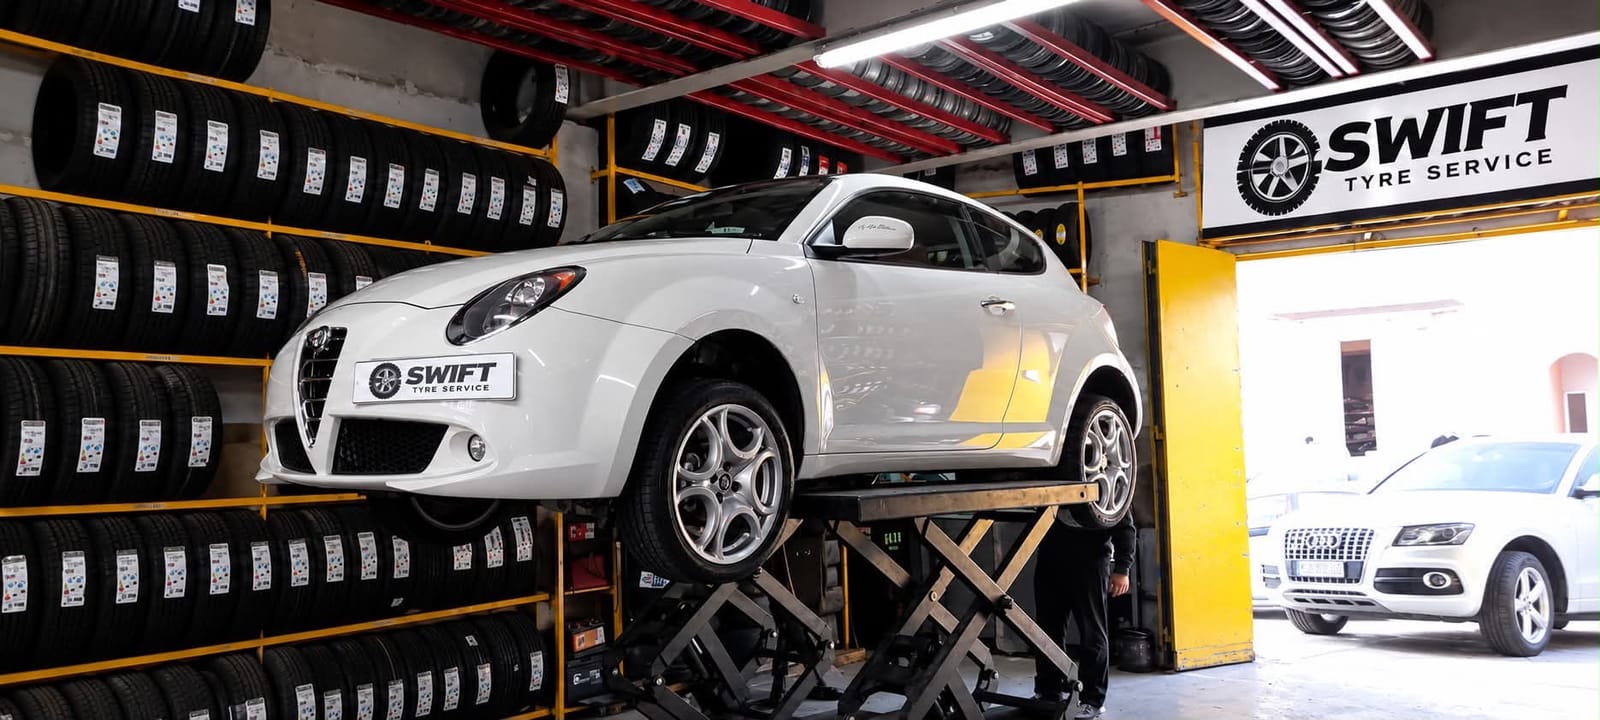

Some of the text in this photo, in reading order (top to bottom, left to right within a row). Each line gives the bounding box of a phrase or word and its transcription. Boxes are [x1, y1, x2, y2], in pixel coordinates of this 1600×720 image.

[1324, 84, 1568, 172] SWIFT
[1345, 148, 1553, 191] TYRE SERVICE
[405, 362, 497, 385] SWIFT
[442, 384, 490, 392] SERVICE
